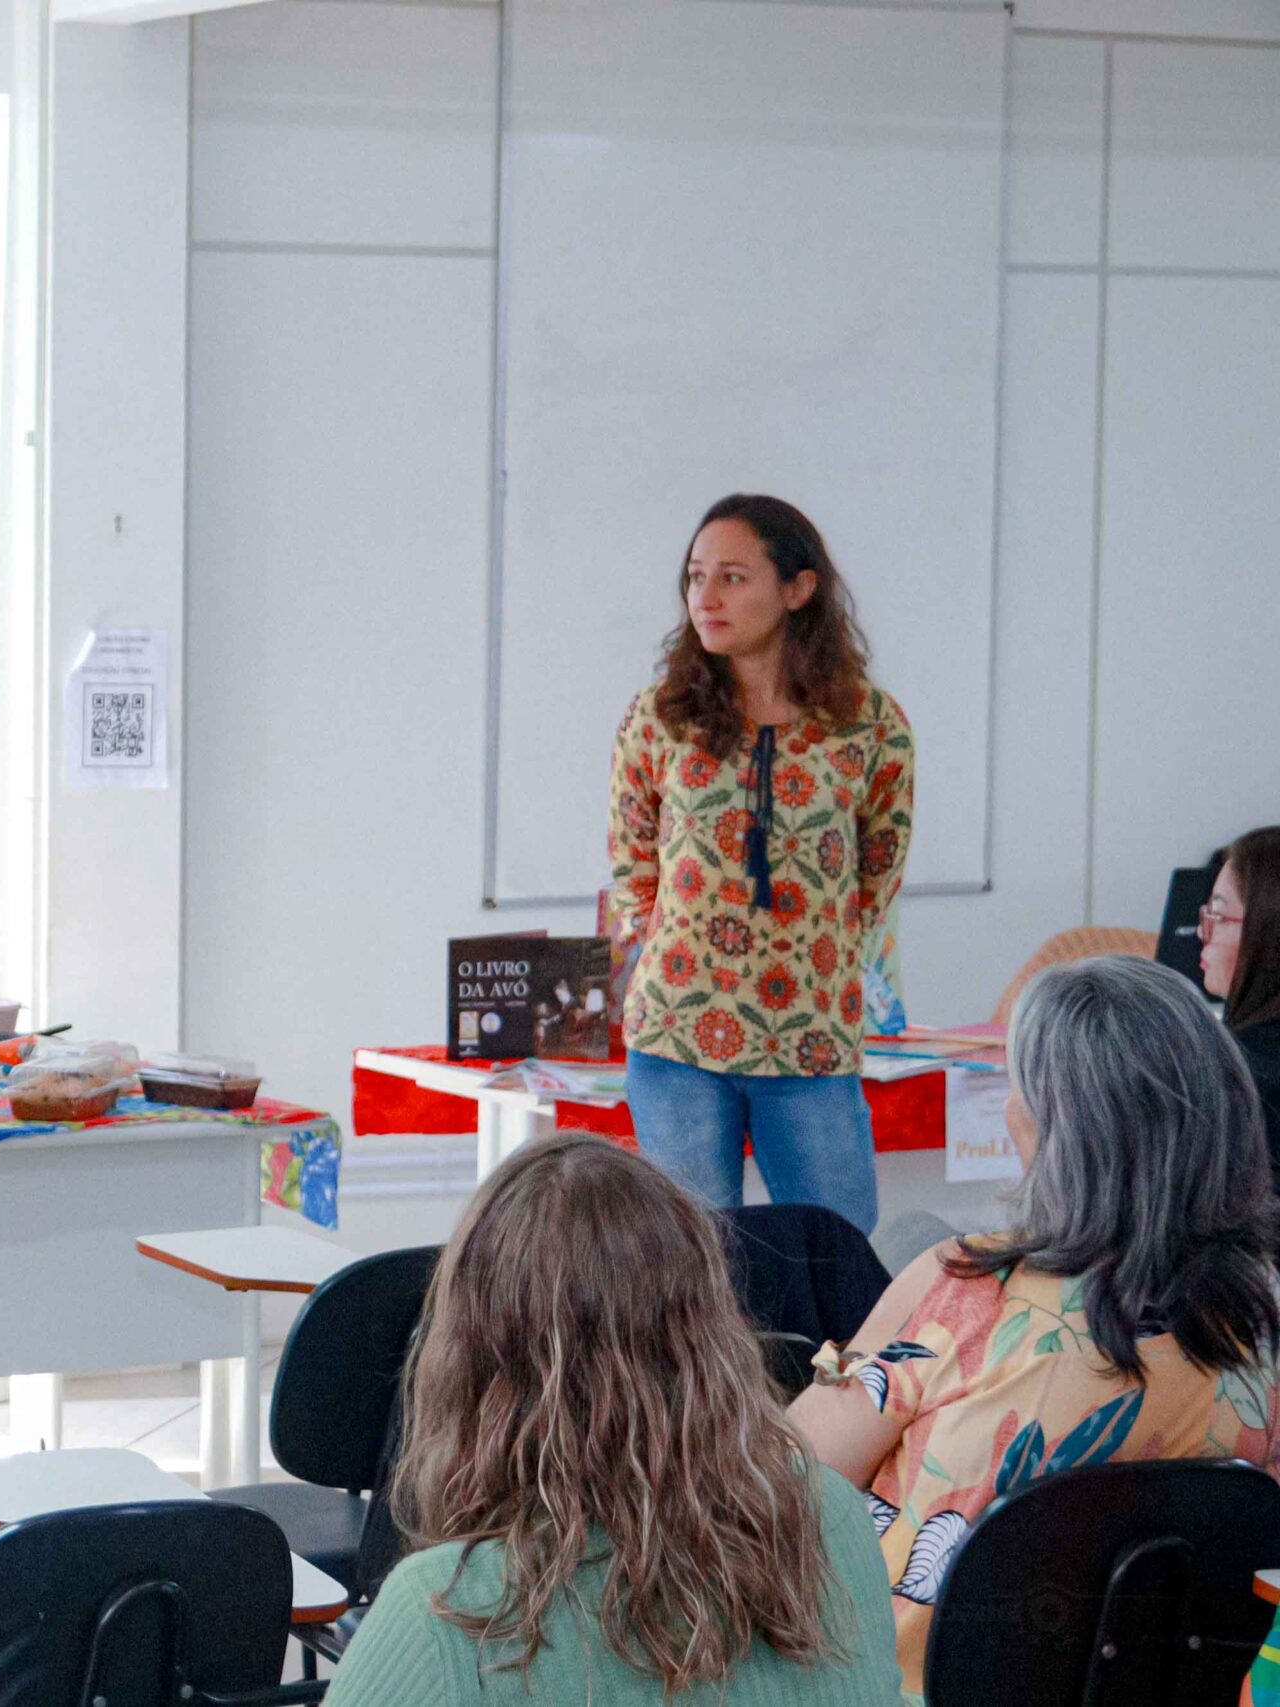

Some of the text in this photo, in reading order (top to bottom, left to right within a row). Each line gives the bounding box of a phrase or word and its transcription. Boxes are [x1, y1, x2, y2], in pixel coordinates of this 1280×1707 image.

[458, 960, 530, 977] O LIVRO
[458, 978, 529, 998] DA AVÓ
